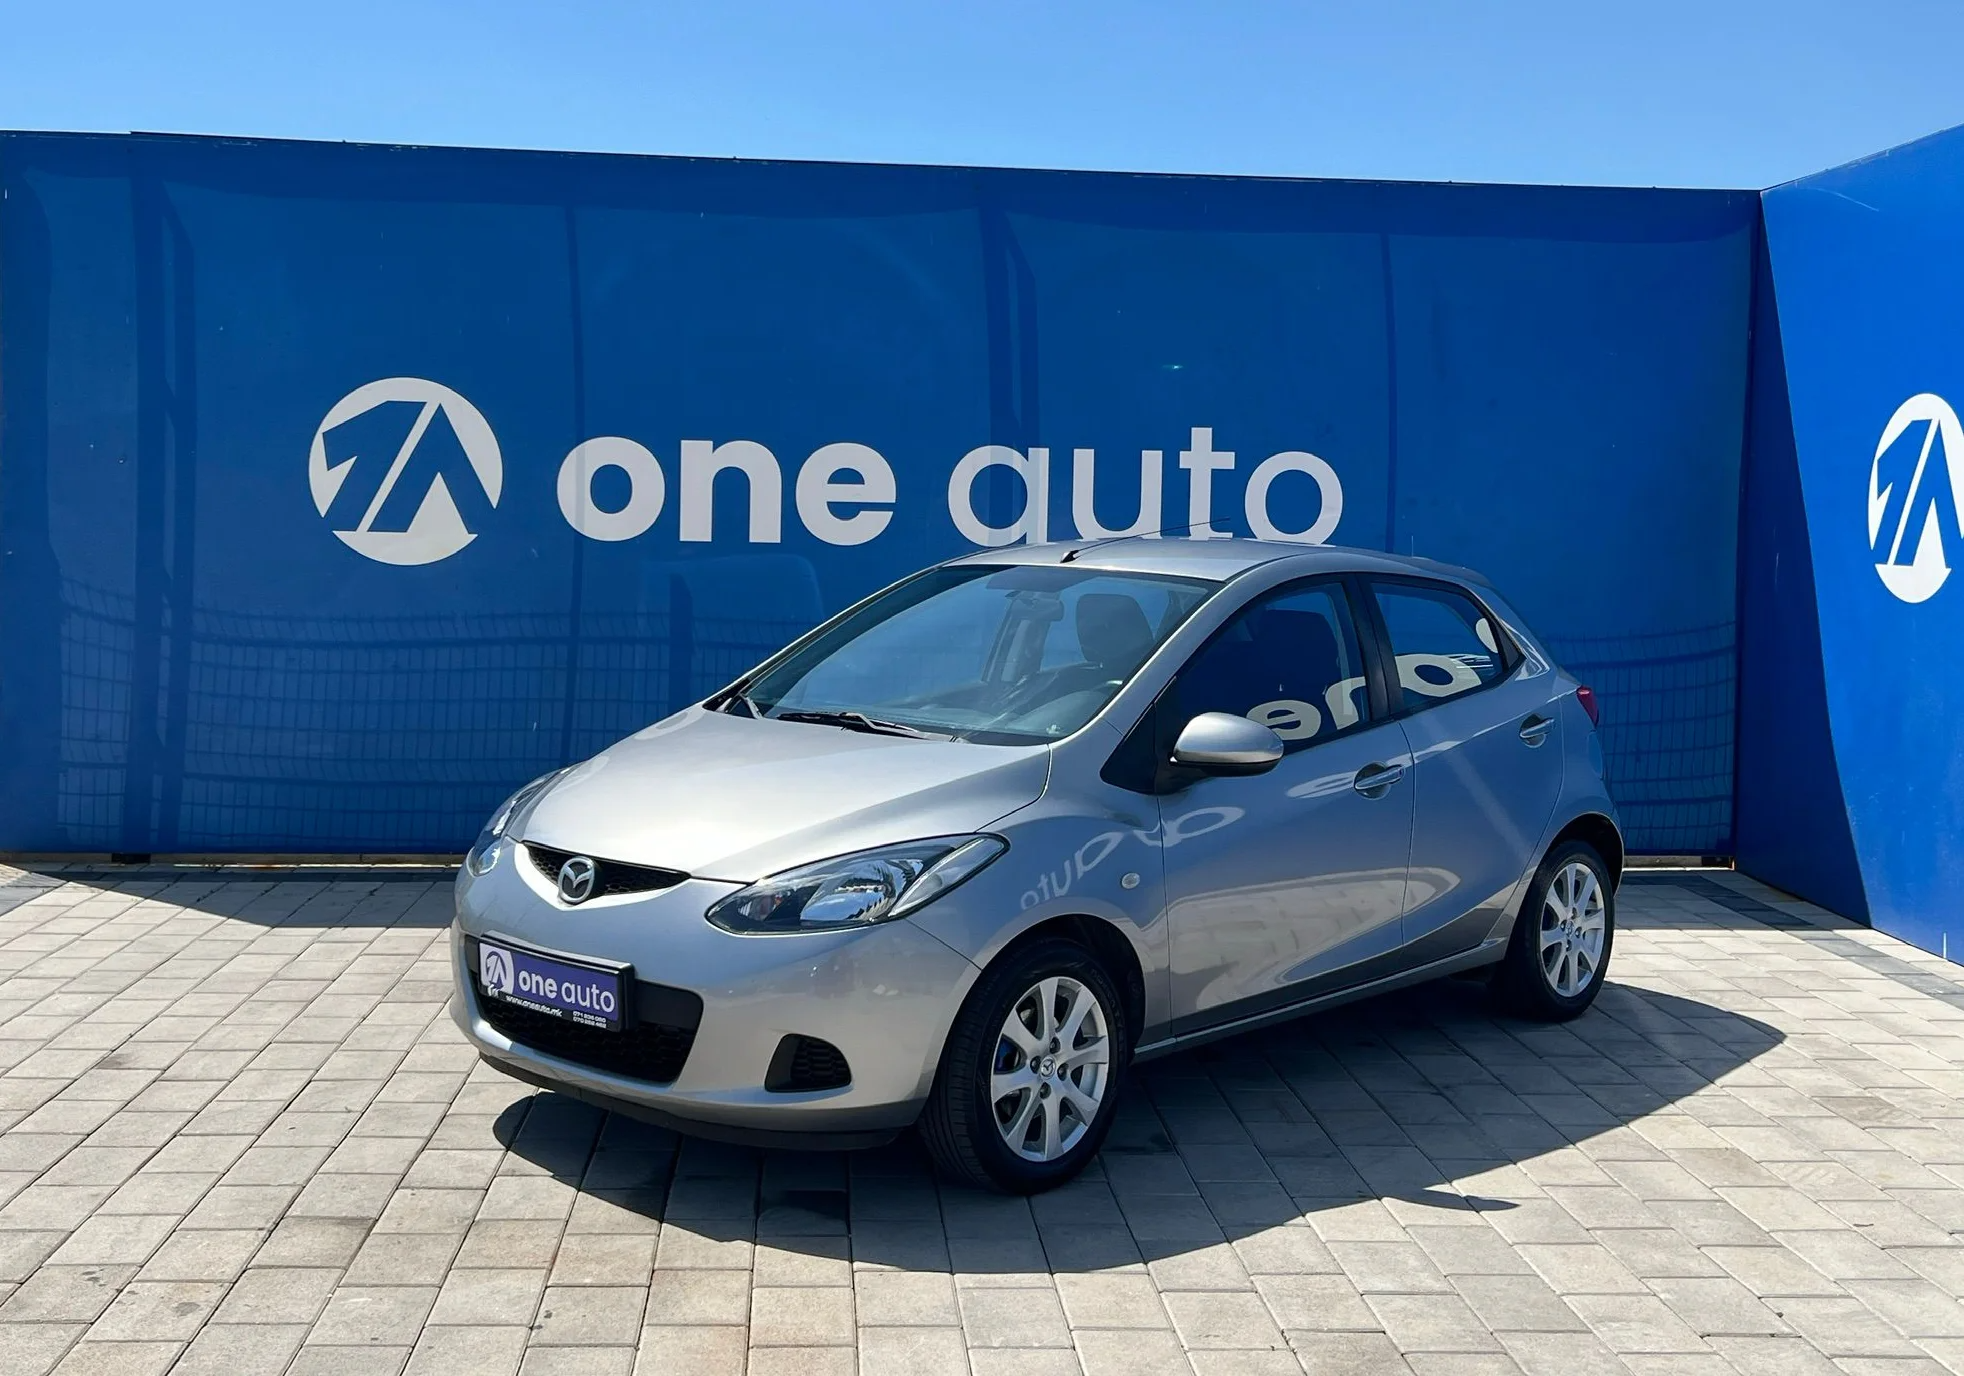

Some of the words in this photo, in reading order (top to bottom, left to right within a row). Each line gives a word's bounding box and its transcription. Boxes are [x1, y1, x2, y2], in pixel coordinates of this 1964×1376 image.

[556, 436, 896, 546] one
[947, 427, 1343, 546] auto
[506, 995, 563, 1017] www.oneauto.mk
[518, 970, 558, 999] one
[561, 982, 615, 1013] auto
